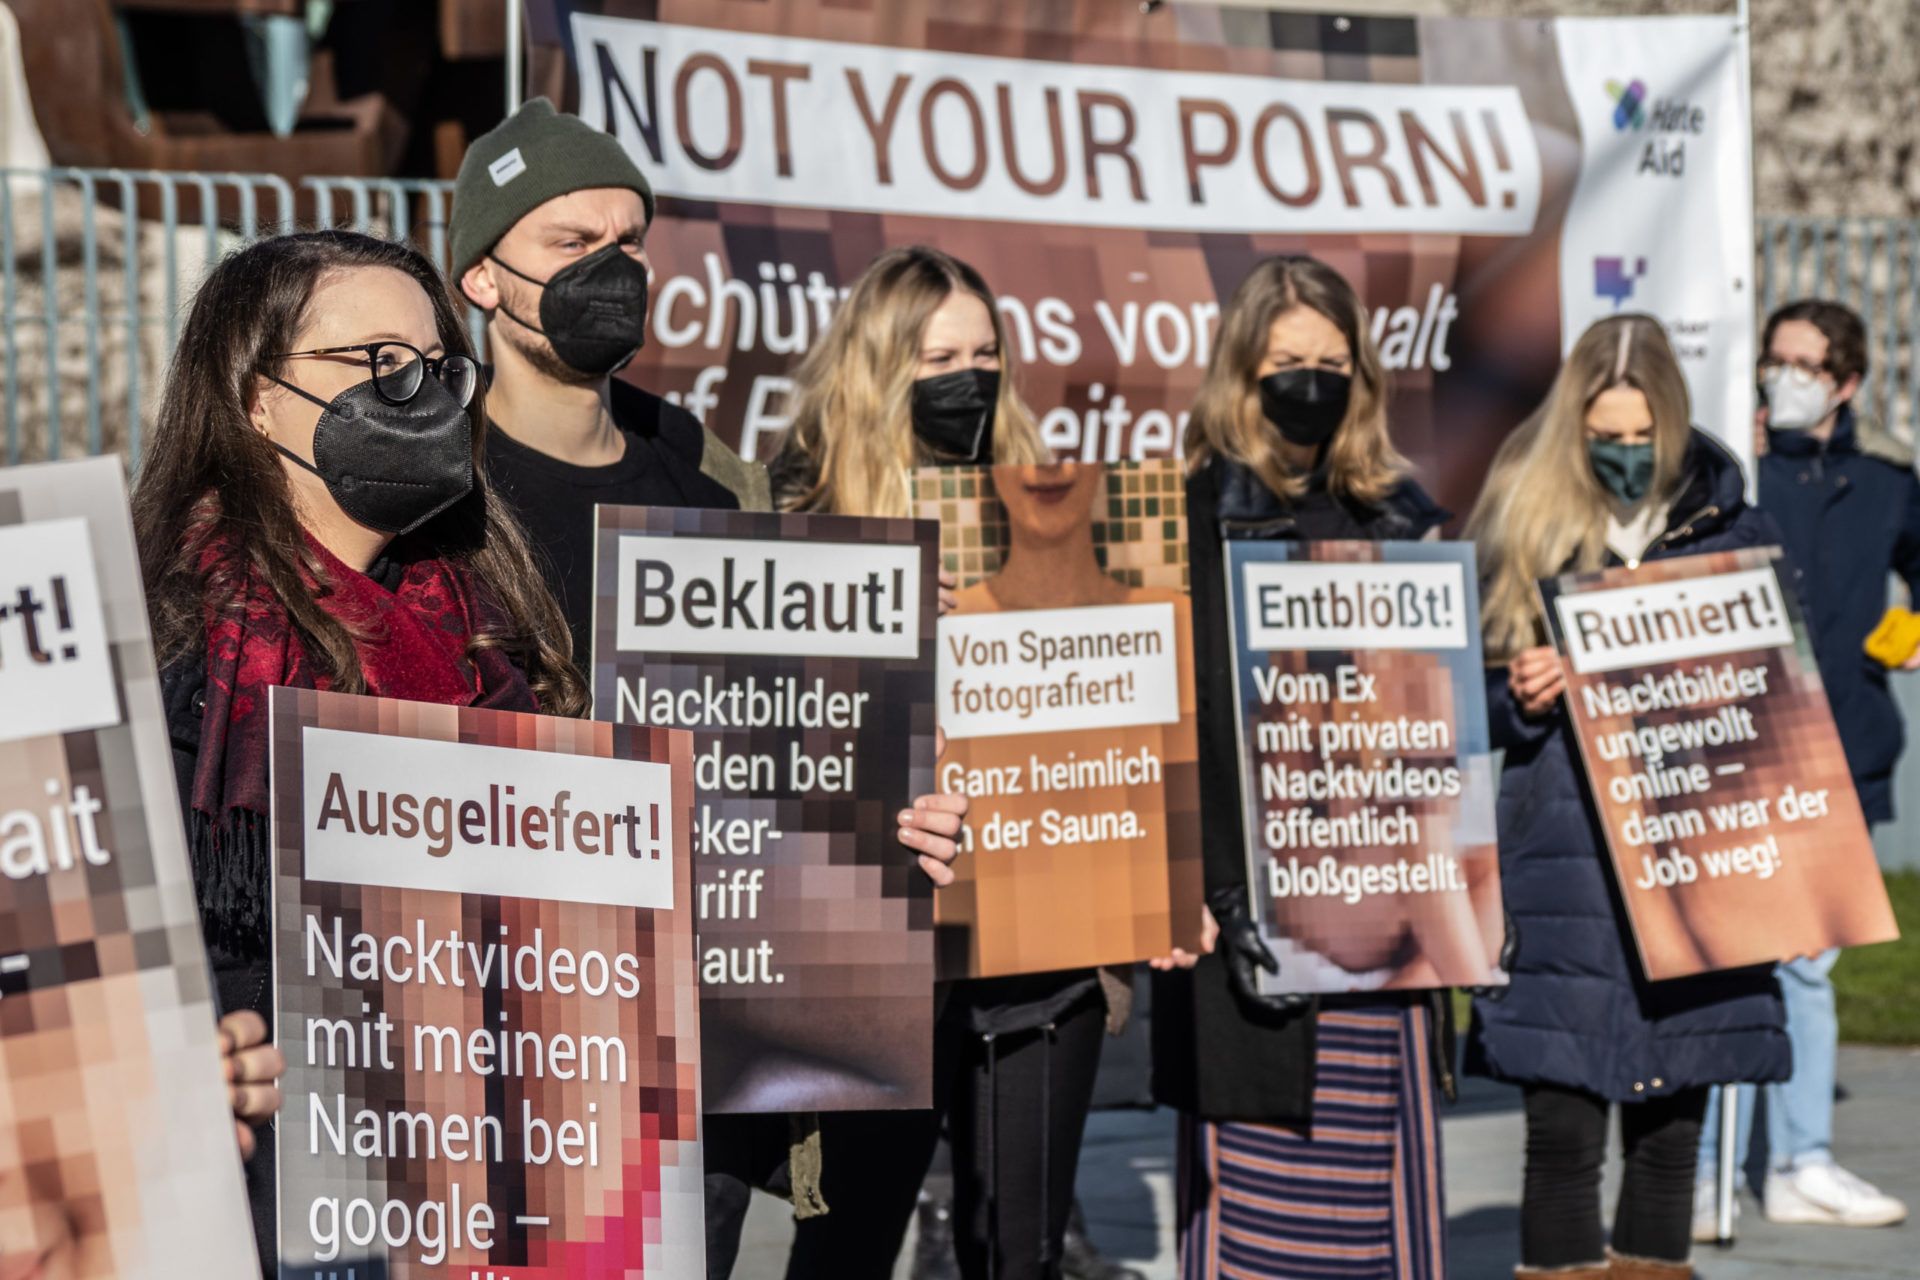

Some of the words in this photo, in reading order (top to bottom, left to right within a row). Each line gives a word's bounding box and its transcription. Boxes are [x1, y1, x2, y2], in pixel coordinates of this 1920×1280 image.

[594, 40, 811, 178] NOT
[844, 67, 1149, 203] YOUR
[1178, 97, 1518, 210] PORN!
[1638, 140, 1684, 177] Aid
[649, 252, 848, 354] chüt
[996, 295, 1083, 366] ns
[1369, 282, 1459, 372] alt
[0, 574, 78, 664] t!
[634, 557, 904, 634] Beklaut!
[1258, 581, 1453, 629] Entblößt!
[1574, 584, 1779, 653] Ruiniert!
[948, 633, 1008, 667] Von
[1018, 629, 1162, 671] Spannern
[616, 676, 869, 729] Nacktbilder
[951, 670, 1135, 719] fotografiert!
[1252, 666, 1330, 703] Vom
[1336, 665, 1377, 702] Ex
[1581, 663, 1768, 719] Nacktbilder
[1257, 712, 1313, 752] mit
[1319, 712, 1449, 758] privaten
[1596, 706, 1758, 762] ungewollt
[693, 740, 776, 792] den
[789, 741, 854, 793] bei
[942, 761, 1023, 797] Ganz
[1030, 746, 1161, 792] heimlich
[1260, 758, 1461, 801] Nacktvideos
[1609, 761, 1712, 804] online
[0, 777, 111, 880] ait
[316, 772, 661, 860] Ausgeliefert!
[694, 804, 782, 855] ker-
[981, 811, 1032, 851] der
[1040, 809, 1146, 846] Sauna.
[1264, 805, 1419, 849] öffentlich
[1622, 811, 1706, 847] dann
[1709, 799, 1770, 833] war
[1777, 785, 1829, 823] der
[1267, 853, 1468, 903] bloßgestellt.
[1635, 848, 1698, 890] Job
[1702, 836, 1783, 879] weg!
[700, 869, 764, 919] riff
[305, 912, 641, 998] Nacktvideos
[696, 939, 784, 984] aut.
[306, 1002, 394, 1071] mit
[414, 1011, 628, 1083] meinem
[308, 1091, 503, 1163] Namen
[523, 1099, 600, 1167] bei
[309, 1183, 496, 1266] google
